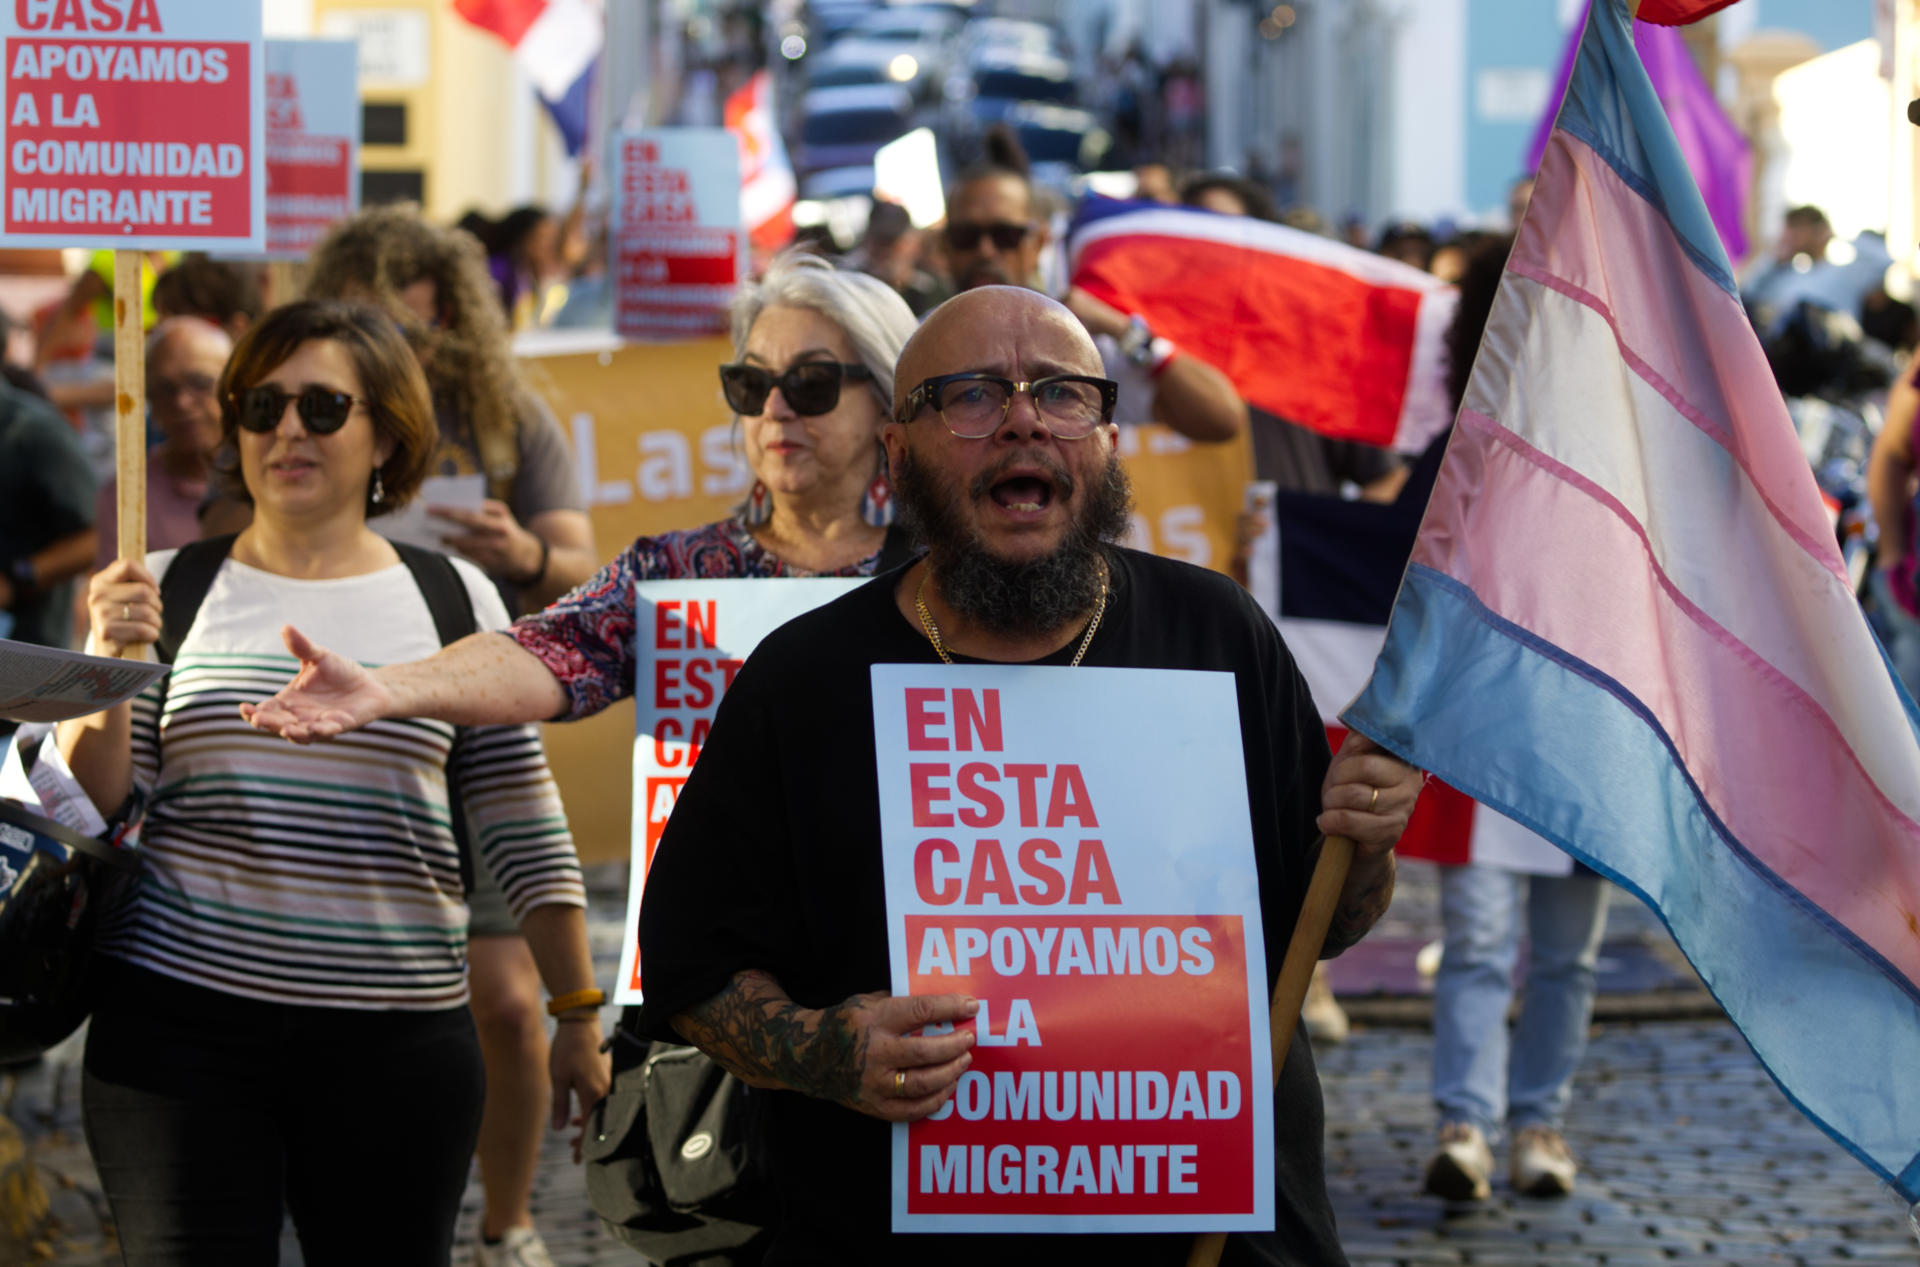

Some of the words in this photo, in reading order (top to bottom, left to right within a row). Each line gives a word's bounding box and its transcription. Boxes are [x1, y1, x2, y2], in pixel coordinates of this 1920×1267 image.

[15, 0, 163, 33] CASA
[12, 45, 229, 83] APOYAMOS
[11, 93, 40, 126] A
[51, 93, 100, 127] LA
[12, 140, 244, 178] COMUNIDAD
[12, 188, 213, 225] MIGRANTE
[571, 412, 749, 506] Las
[655, 600, 717, 650] EN
[655, 657, 745, 711] EST
[654, 717, 713, 769] CA
[904, 687, 1004, 752] EN
[909, 761, 1100, 829] ESTA
[913, 837, 1123, 907] CASA
[917, 926, 1215, 977] APOYAMOS
[975, 998, 1043, 1047] LA
[920, 1143, 1199, 1194] MIGRANTE
